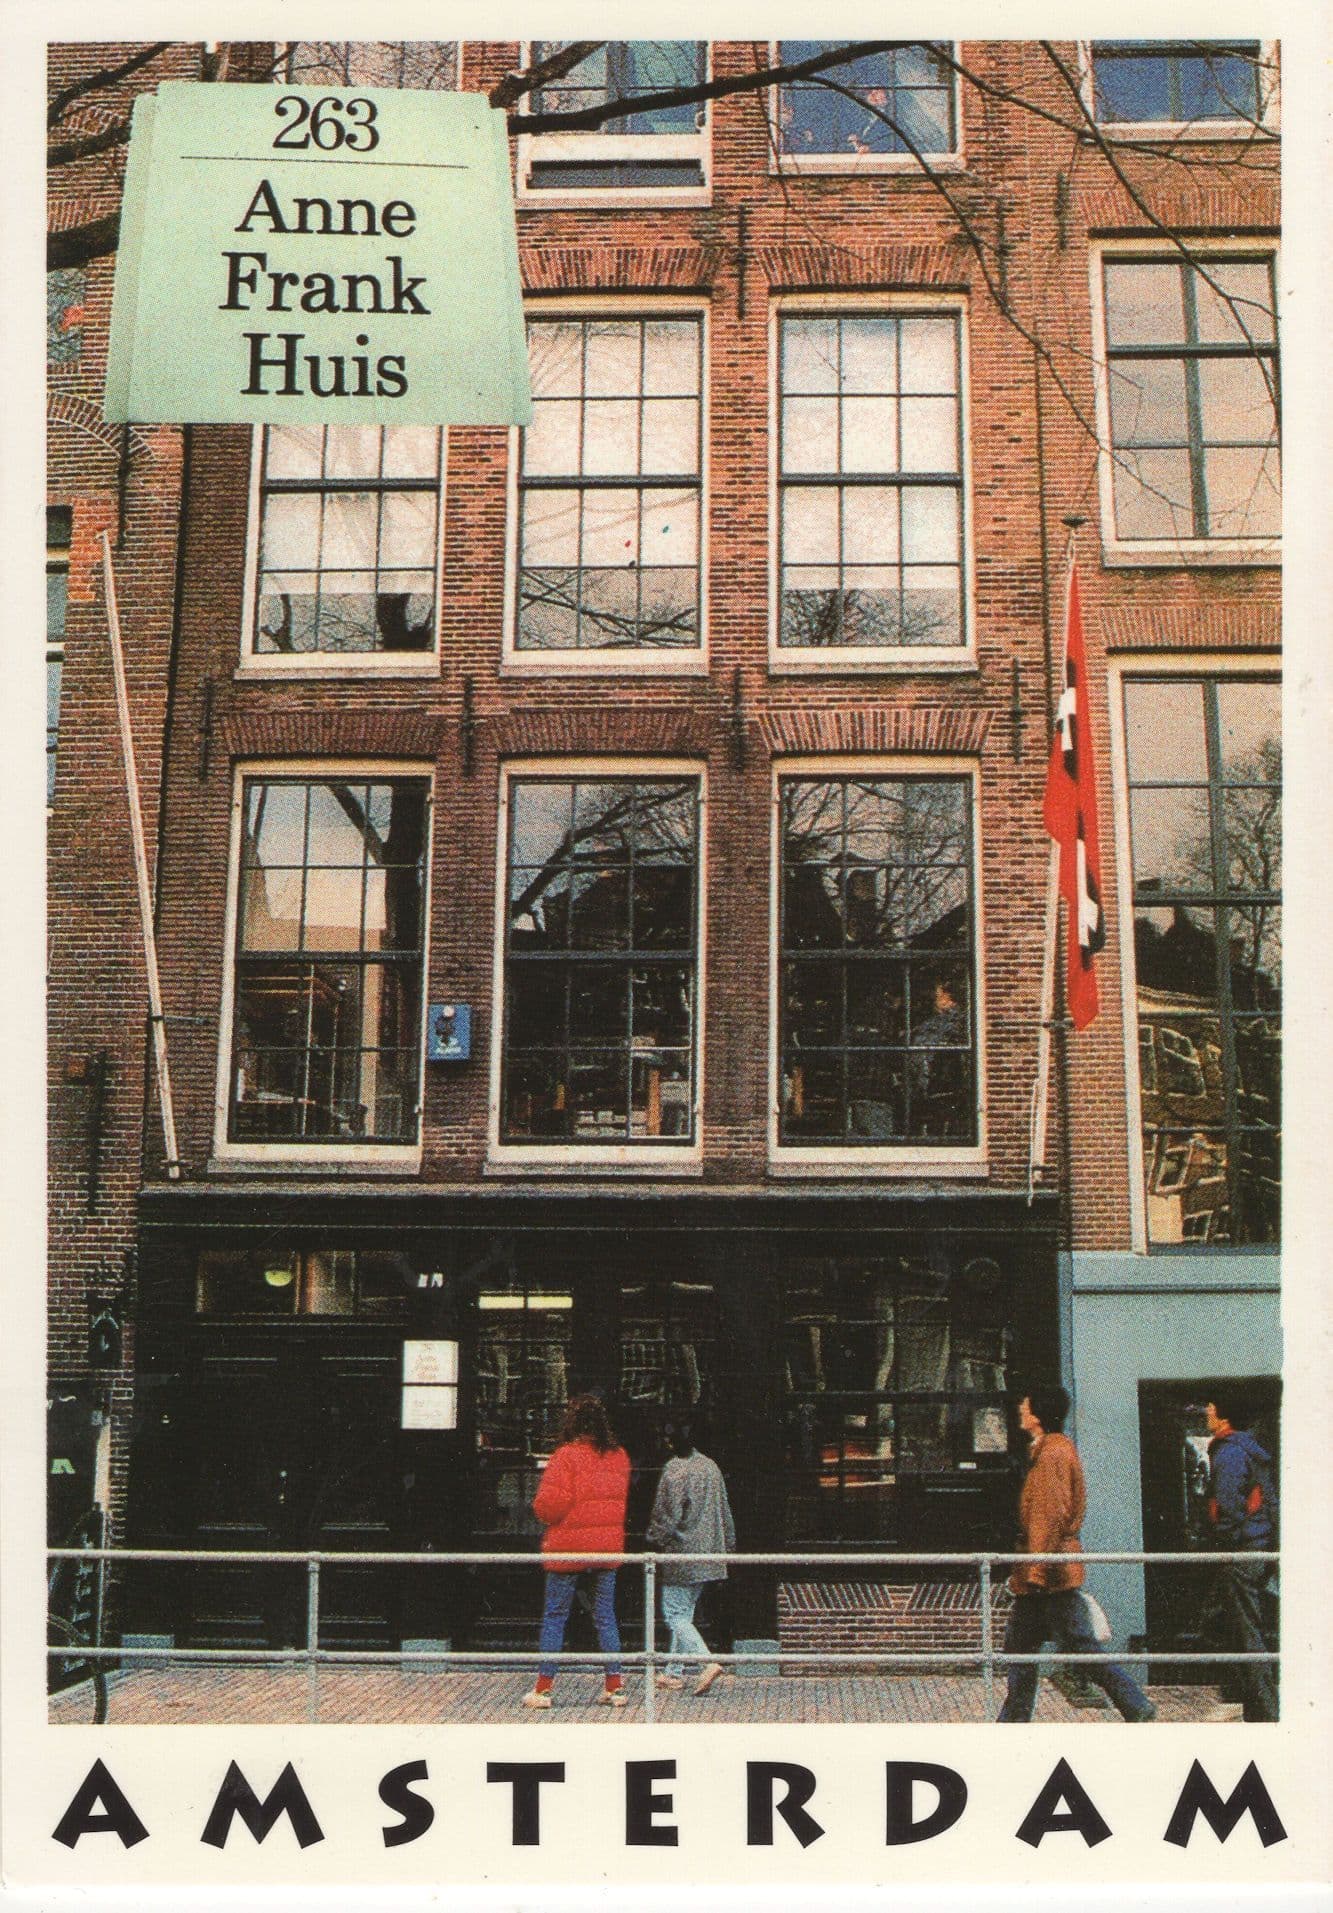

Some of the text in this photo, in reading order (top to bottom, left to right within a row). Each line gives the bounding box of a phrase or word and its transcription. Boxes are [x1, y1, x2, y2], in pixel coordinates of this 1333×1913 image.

[273, 96, 380, 151] 263
[235, 180, 416, 237] Anne
[219, 252, 431, 315] Frank
[241, 333, 409, 398] Huis
